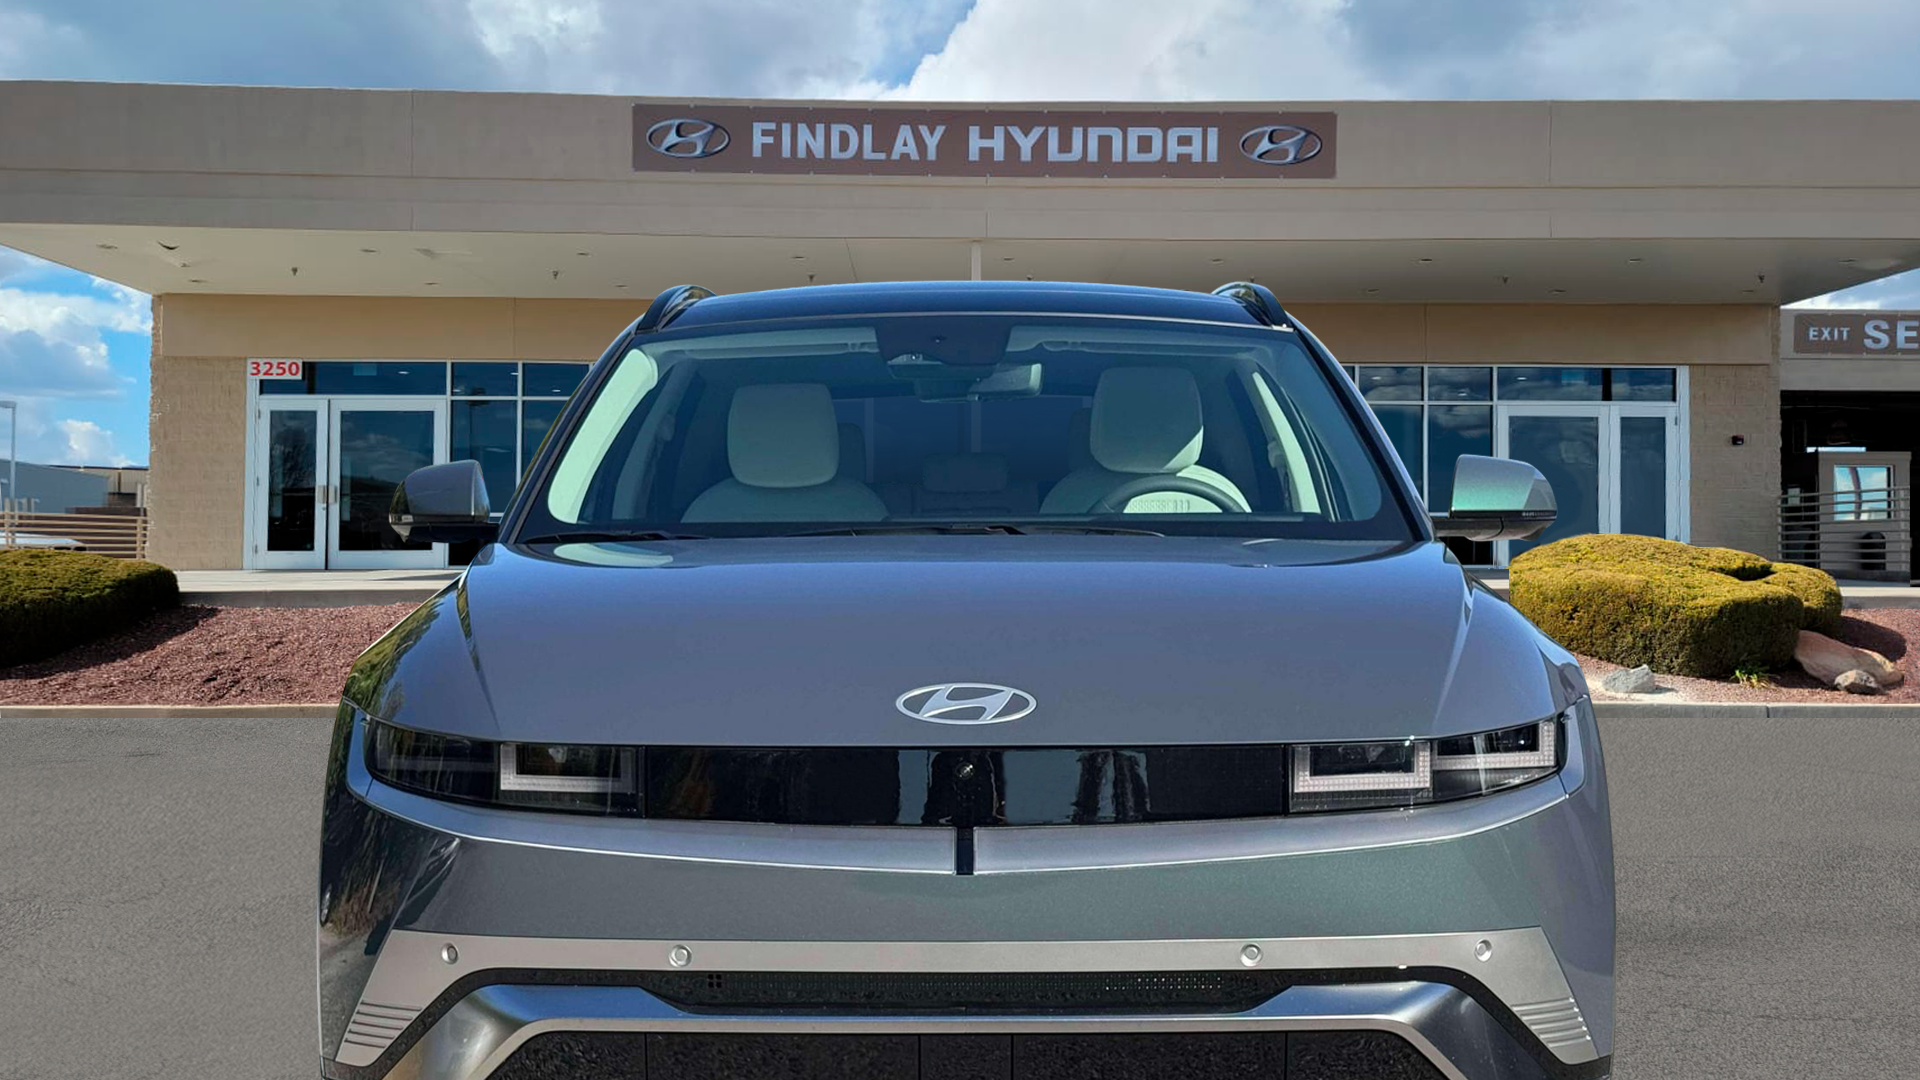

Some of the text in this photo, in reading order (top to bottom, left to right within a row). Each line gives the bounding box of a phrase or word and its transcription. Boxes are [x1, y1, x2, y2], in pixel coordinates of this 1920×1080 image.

[752, 122, 1219, 162] FINDLAY HYUNDAI
[1809, 319, 1920, 350] EXIT SE
[250, 361, 300, 376] 3250
